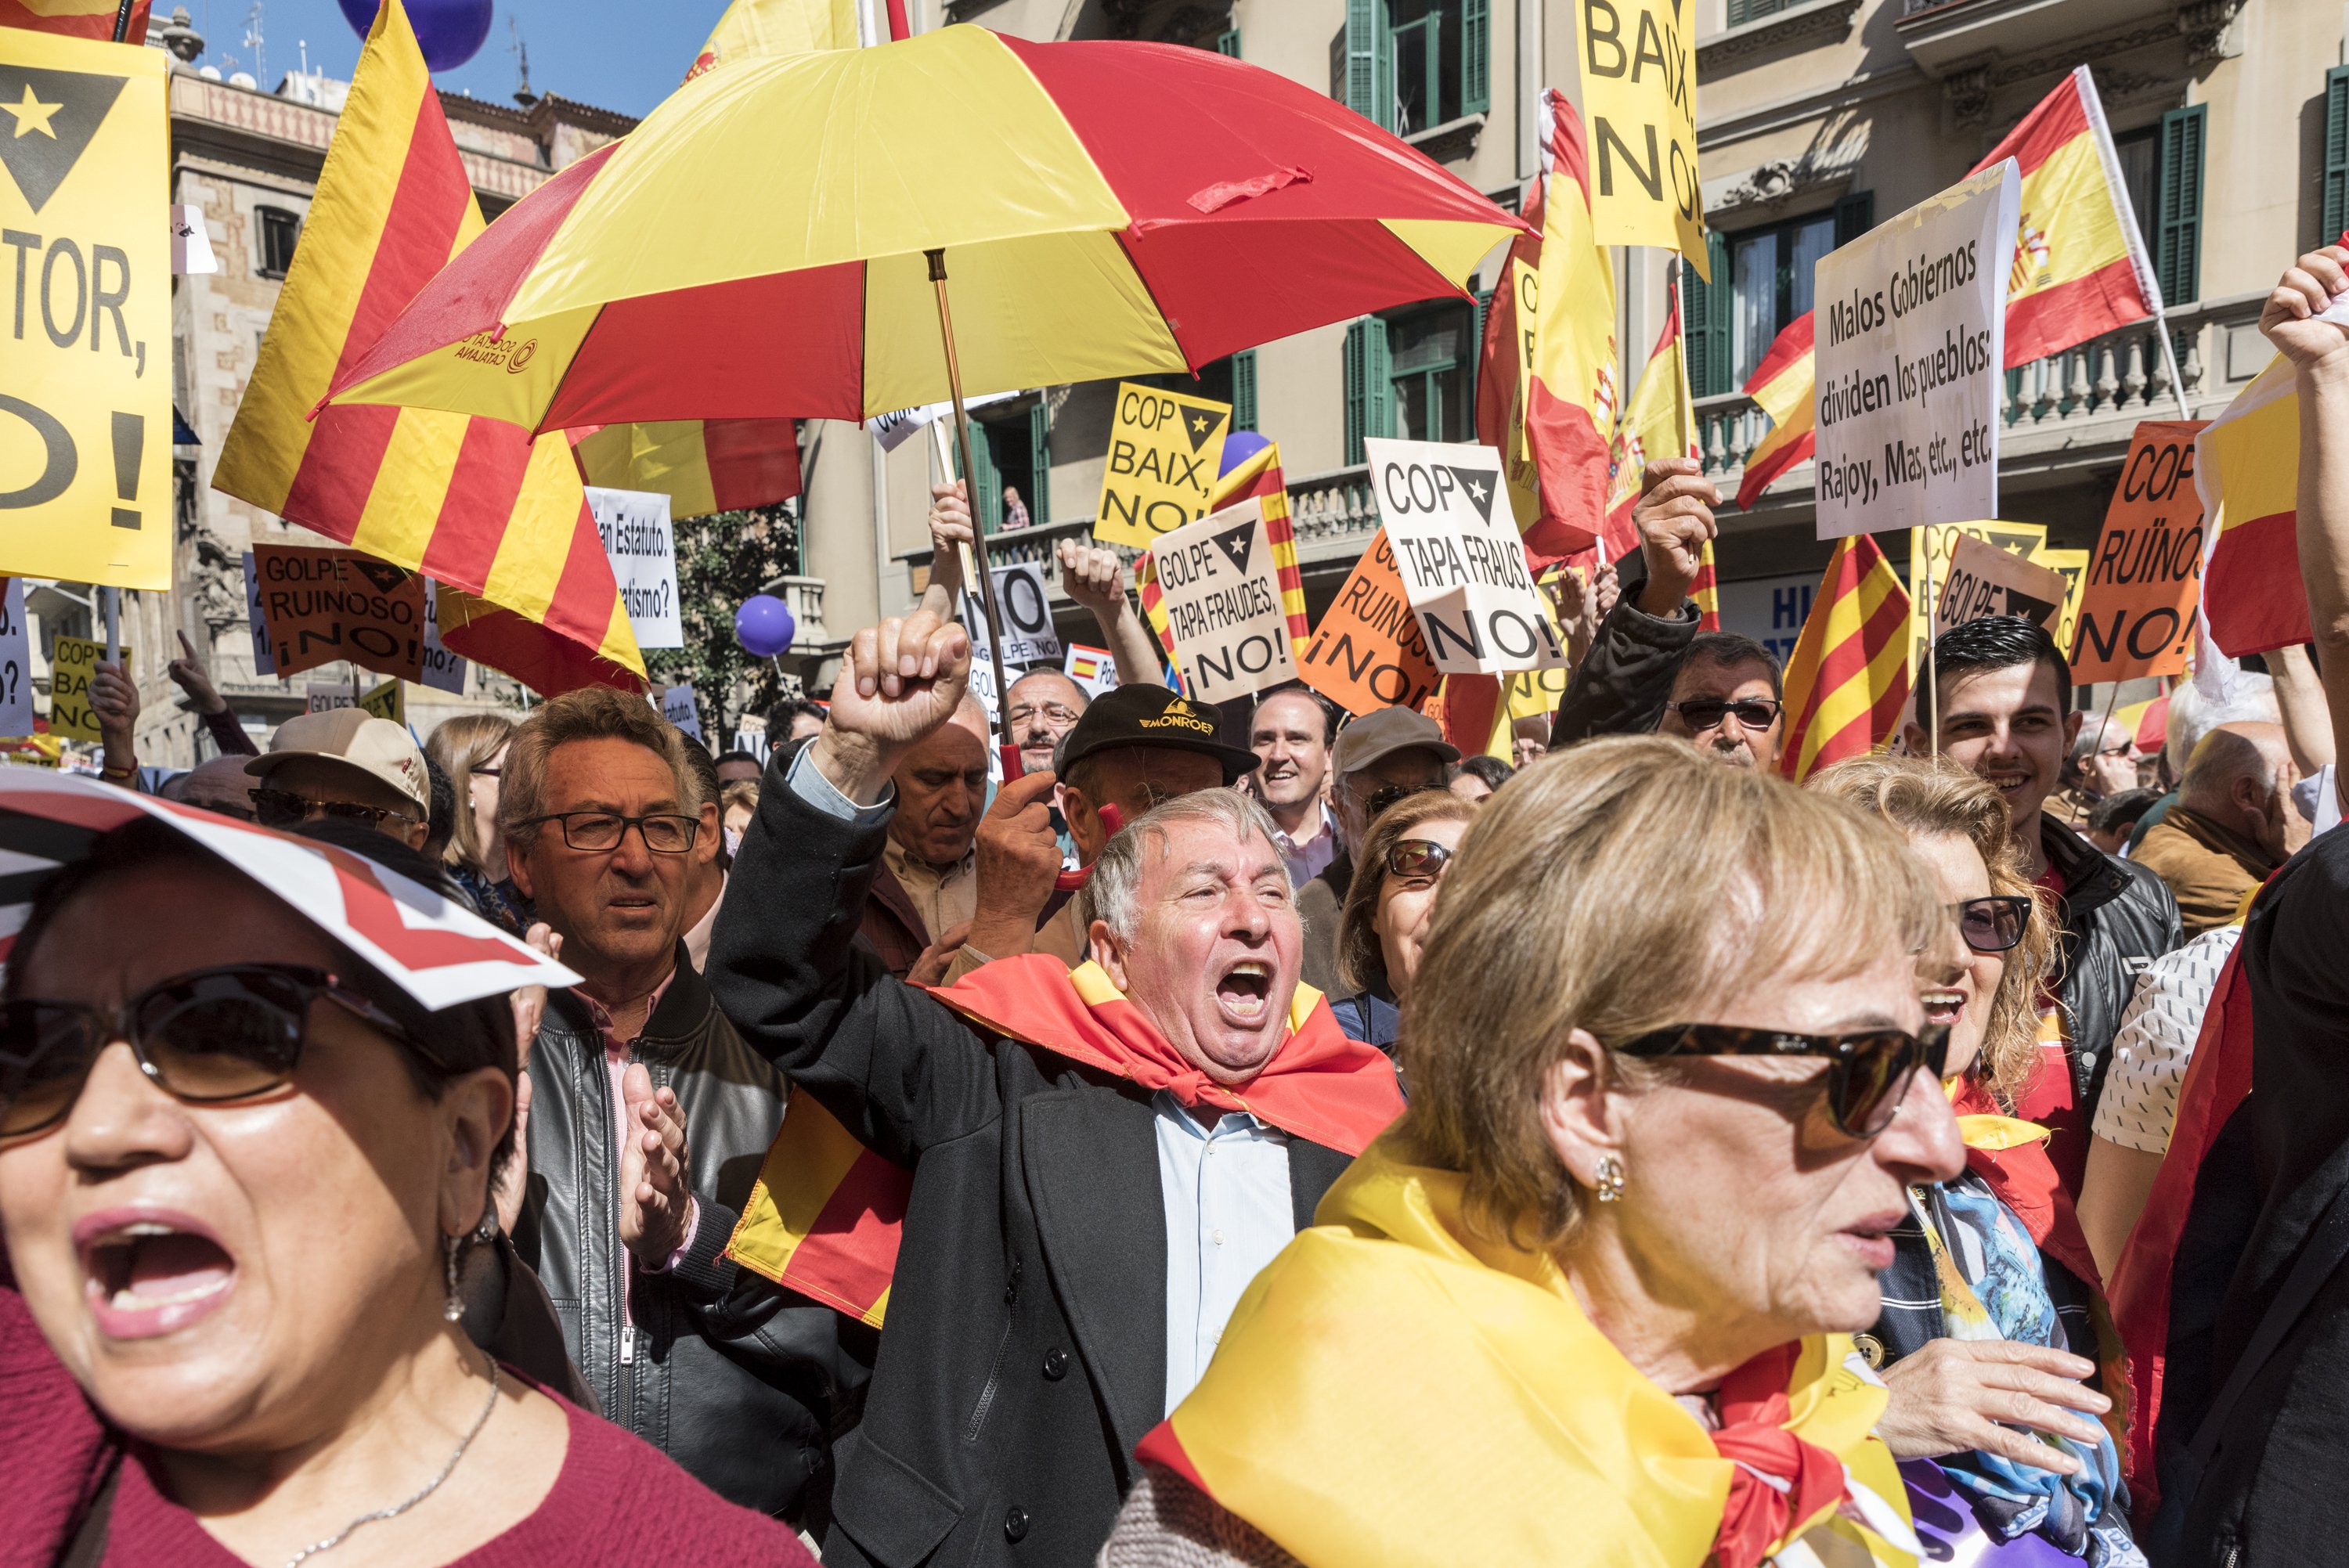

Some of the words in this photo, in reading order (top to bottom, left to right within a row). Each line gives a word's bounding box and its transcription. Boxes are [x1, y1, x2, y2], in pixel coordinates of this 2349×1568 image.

[1584, 0, 1694, 142] BAIX,
[1594, 116, 1703, 238] NO!
[1830, 287, 1886, 347] Malos
[1889, 240, 1976, 319] Gobiernos
[1820, 369, 1892, 427] dividen
[1895, 355, 1917, 402] los
[1918, 323, 1990, 409] pueblos:
[1122, 391, 1175, 431] COP
[1110, 439, 1210, 499] BAIX,
[1385, 462, 1455, 514] COP
[1820, 452, 1878, 509] Rajoy,
[1885, 440, 1927, 490] Mas,
[1929, 431, 1958, 482] etc.,
[1961, 418, 1992, 468] etc.
[2123, 443, 2196, 503] COP
[615, 513, 667, 557] Estatuto.
[265, 556, 349, 582] GOLPE
[1160, 539, 1218, 591] GOLPE
[1399, 535, 1470, 587] TAPA
[1462, 534, 1535, 599] FRAUS,
[269, 589, 420, 633] RUINOSO,
[619, 577, 669, 618] atismo?
[1169, 598, 1208, 642] TAPA
[1205, 575, 1278, 631] FRAUDES,
[1940, 568, 2004, 626] GOLPE
[57, 640, 95, 665] COP
[278, 622, 418, 666] ¡NO!
[976, 643, 1034, 661] GLPE,
[1035, 640, 1061, 656] NO!
[1422, 609, 1562, 661] NO!
[2070, 605, 2199, 666] NO!
[1182, 627, 1287, 701] ¡NO!
[1149, 716, 1211, 734] MONROE
